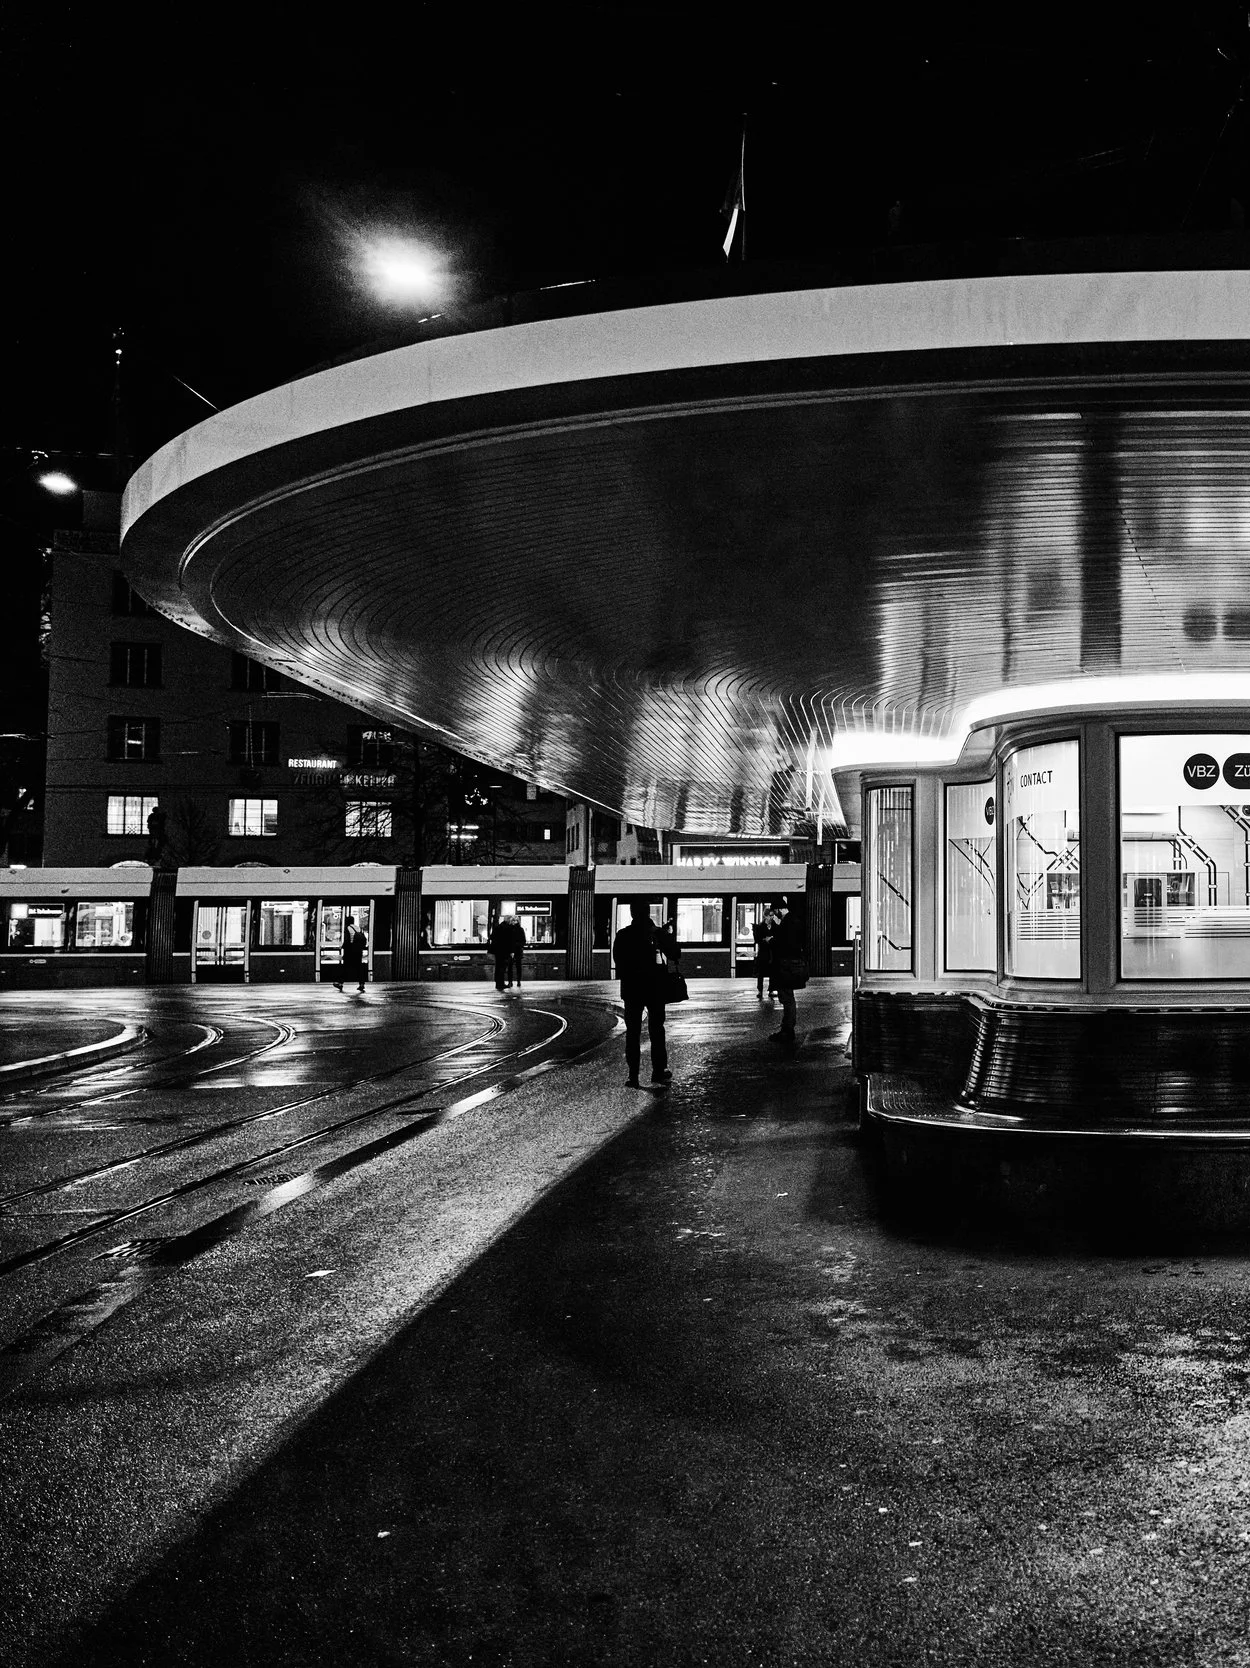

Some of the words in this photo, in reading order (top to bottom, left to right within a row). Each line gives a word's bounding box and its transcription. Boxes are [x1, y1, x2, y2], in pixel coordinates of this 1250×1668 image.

[288, 759, 337, 769] RESTAURANT
[1187, 765, 1216, 777] VBZ
[1020, 770, 1053, 788] CONTACT
[676, 855, 719, 867] HARRY
[722, 855, 781, 867] WINSTON
